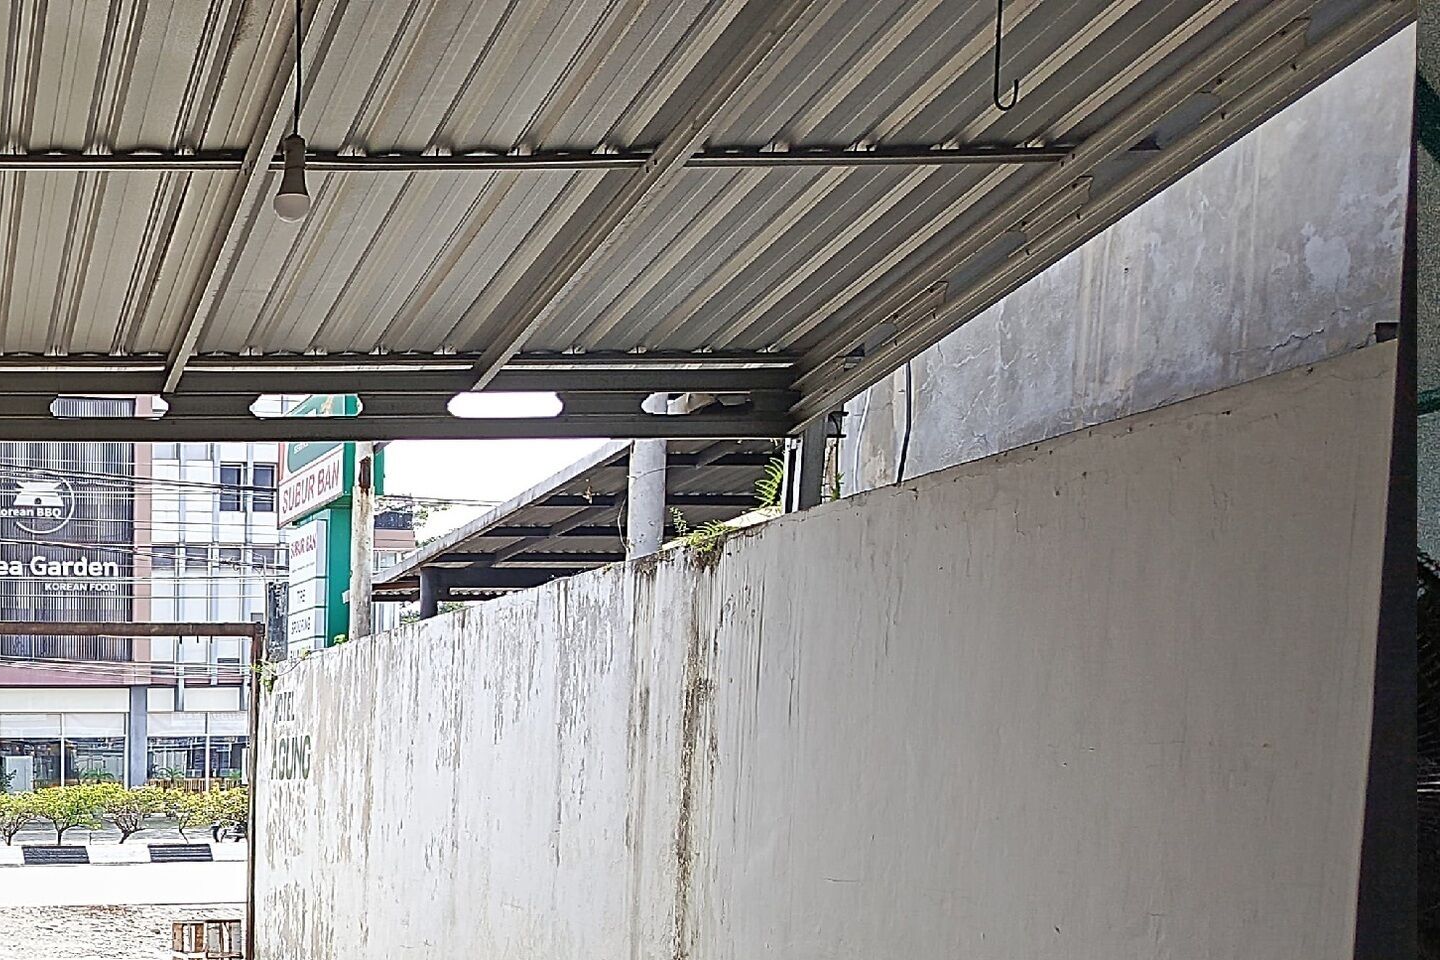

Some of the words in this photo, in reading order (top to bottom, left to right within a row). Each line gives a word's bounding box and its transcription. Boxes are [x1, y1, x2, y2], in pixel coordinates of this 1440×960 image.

[282, 474, 315, 514] SUBUR
[317, 459, 340, 496] BAN
[37, 507, 61, 518] BBQ
[30, 556, 119, 576] Garden
[45, 583, 87, 592] KOREAN
[89, 583, 117, 592] FOOD
[270, 735, 311, 780] AGUNG
